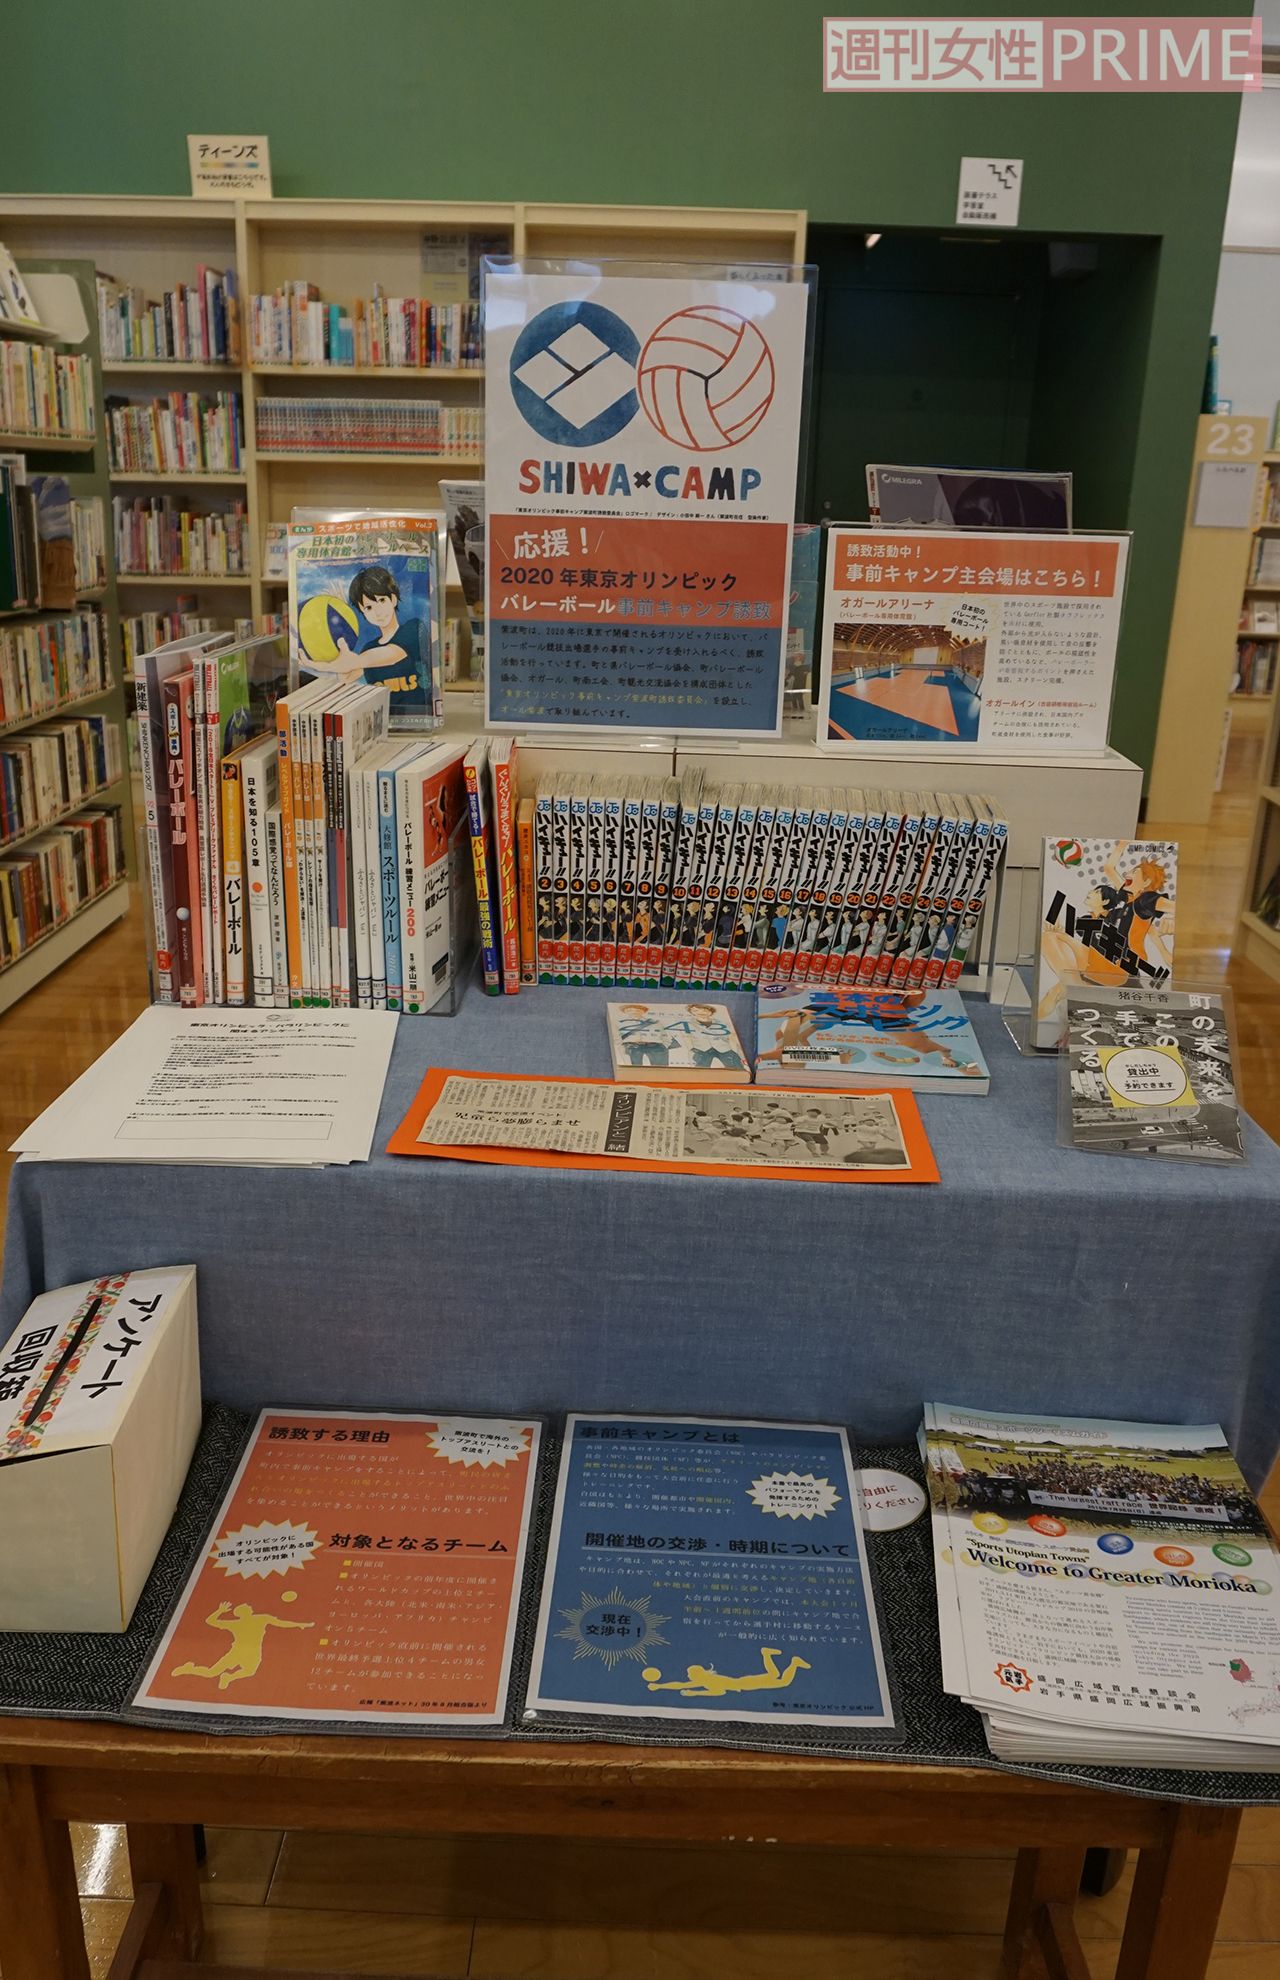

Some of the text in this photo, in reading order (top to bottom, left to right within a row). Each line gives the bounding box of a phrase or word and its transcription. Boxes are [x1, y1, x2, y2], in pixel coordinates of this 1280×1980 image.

[198, 144, 258, 158] ティーンズ
[1207, 423, 1255, 456] 23
[513, 527, 589, 560] 応援!
[847, 543, 921, 559] 誘致活動中!
[846, 563, 1101, 589] 事前キャンプ主会場はこちら!
[840, 597, 935, 610] オガールアリーナ
[961, 603, 986, 616] 日本初の
[952, 610, 989, 625] バレーボール
[136, 682, 149, 711] 新建築
[168, 759, 187, 845] バレーボール
[247, 777, 260, 867] 日本を知る105章
[404, 823, 413, 865] バレーボール
[268, 822, 280, 906] 国際感覚ってなんだろう
[472, 839, 488, 899] バレーボール
[541, 879, 548, 887] 2
[557, 880, 564, 888] 3
[573, 881, 580, 889] 4
[606, 881, 613, 890] 6
[624, 883, 631, 892] 7
[658, 884, 665, 893] 9
[501, 848, 517, 935] バレーボール
[673, 888, 685, 897] 10
[707, 888, 718, 896] 12
[727, 888, 738, 897] 13
[763, 889, 774, 898] 15
[780, 890, 791, 899] 16
[813, 891, 825, 900] 18
[383, 856, 398, 944] スポーツルール
[830, 894, 842, 903] 19
[865, 894, 877, 903] 21
[883, 896, 894, 904] 22
[918, 898, 929, 906] 24
[935, 899, 946, 907] 25
[969, 901, 981, 910] 27
[226, 878, 242, 955] バレーボール
[1115, 1010, 1139, 1047] 手で
[1155, 1012, 1179, 1047] この
[1188, 994, 1225, 1100] 町の未来を
[1126, 1067, 1160, 1077] 貸出中
[1124, 1081, 1174, 1090] 予約できます
[80, 1294, 162, 1398] アンケート
[268, 1426, 390, 1443] 誘致する理由
[580, 1426, 742, 1444] 事前キャンプとは
[328, 1533, 508, 1553] 対象となるチーム
[585, 1533, 850, 1557] 開催地の交渉・時期について
[1005, 1547, 1048, 1560] Utopian
[967, 1548, 1257, 1594] Welcome to Greater Morioka
[602, 1613, 631, 1625] 現在
